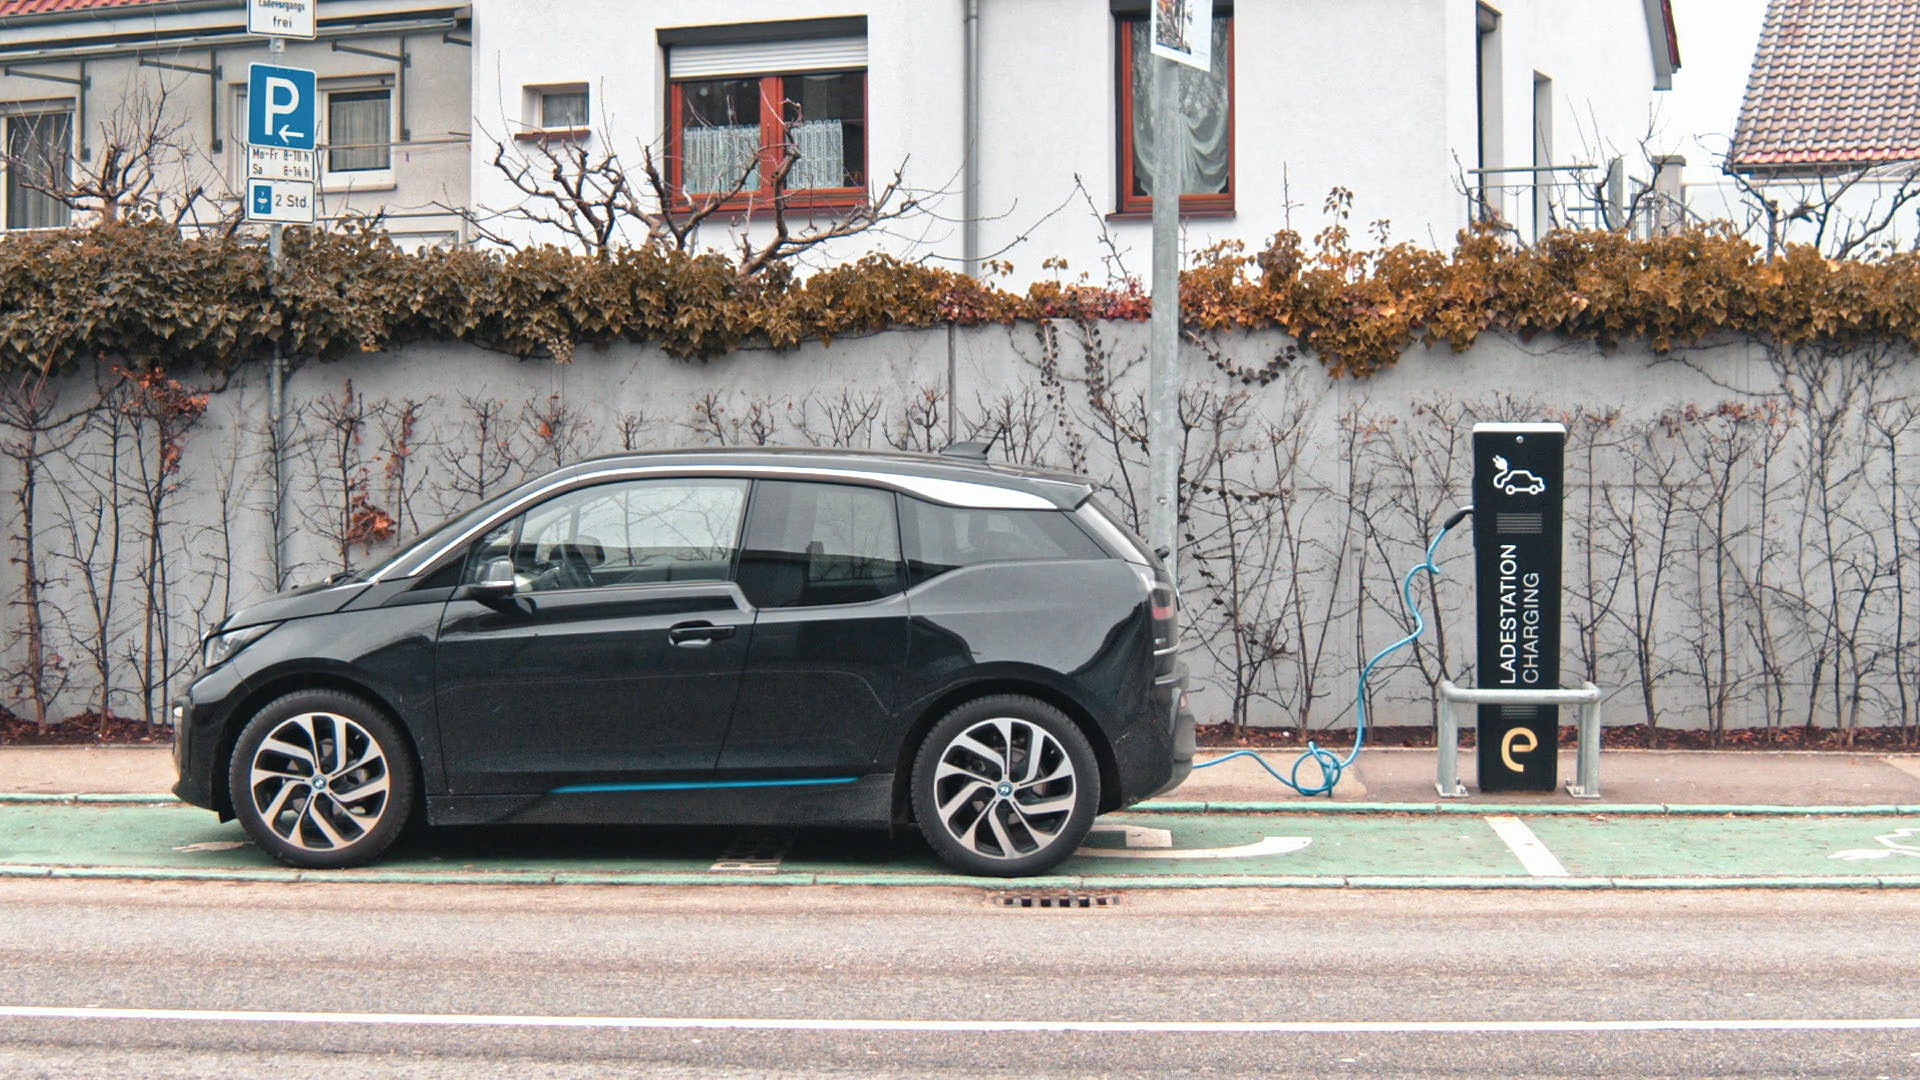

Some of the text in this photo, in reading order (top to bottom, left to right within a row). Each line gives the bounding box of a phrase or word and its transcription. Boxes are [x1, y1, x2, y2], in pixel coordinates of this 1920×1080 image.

[273, 16, 292, 28] frei
[264, 76, 300, 136] P
[252, 163, 263, 175] Sa
[304, 166, 310, 177] h
[275, 193, 310, 208] 2 Std.
[1500, 544, 1517, 684] LADESTATION
[1523, 572, 1539, 684] CHARGING
[1501, 726, 1538, 773] e
